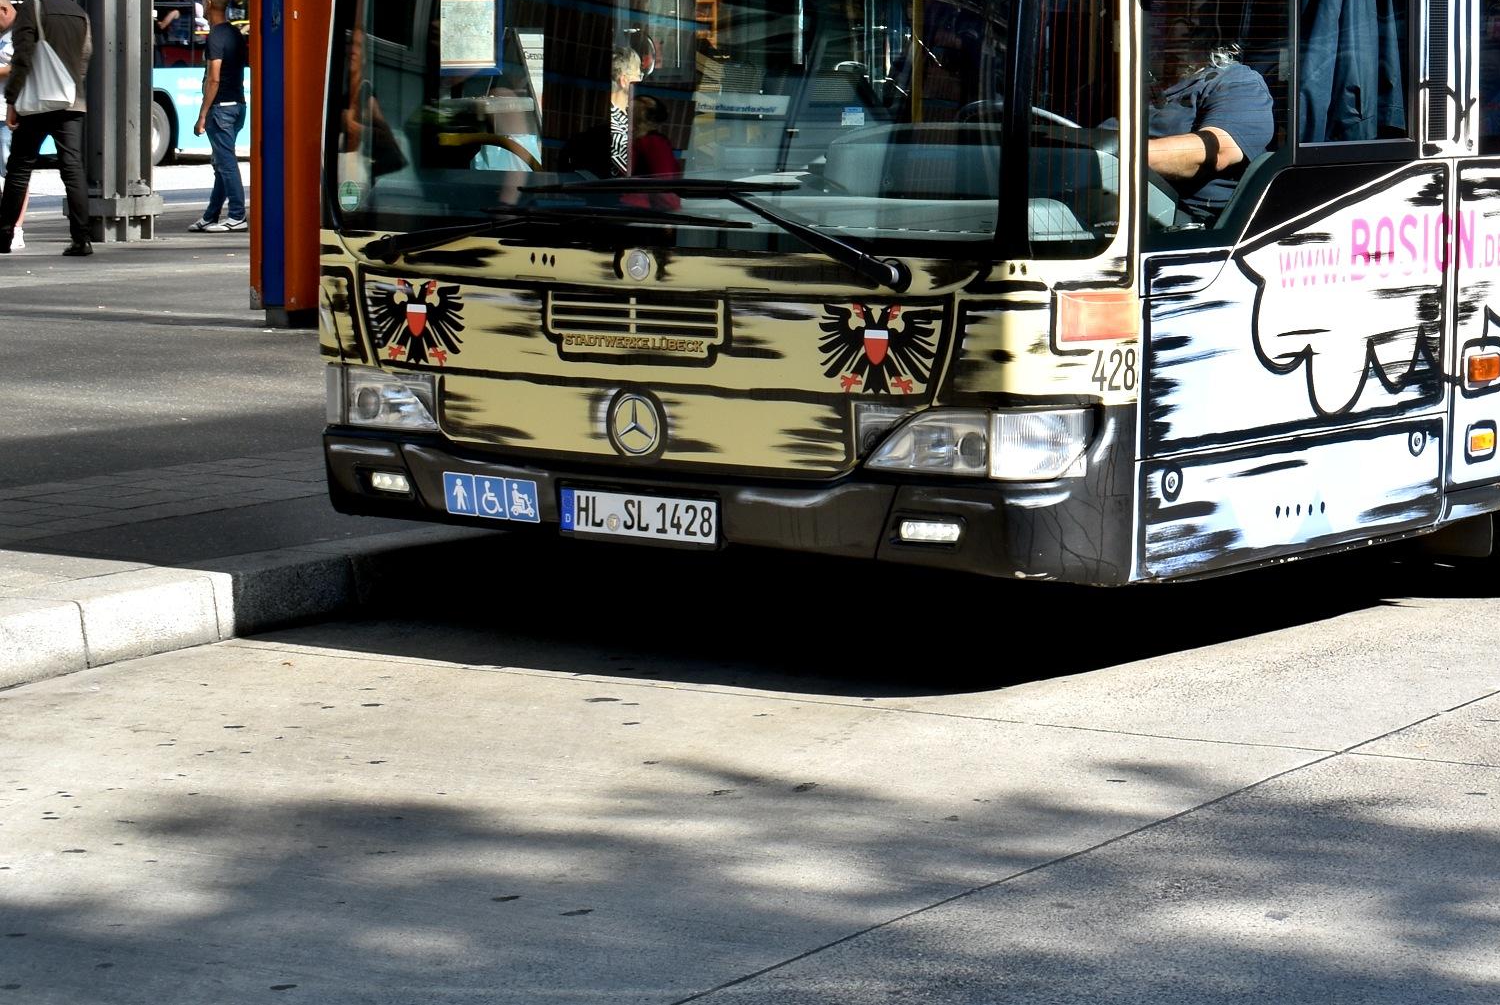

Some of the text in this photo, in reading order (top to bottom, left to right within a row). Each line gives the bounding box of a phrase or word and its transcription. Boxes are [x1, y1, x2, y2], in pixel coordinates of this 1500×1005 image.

[565, 333, 704, 353] STADTWERKE LÜBECK
[1091, 348, 1136, 392] 428
[576, 495, 713, 538] HL SL 1428
